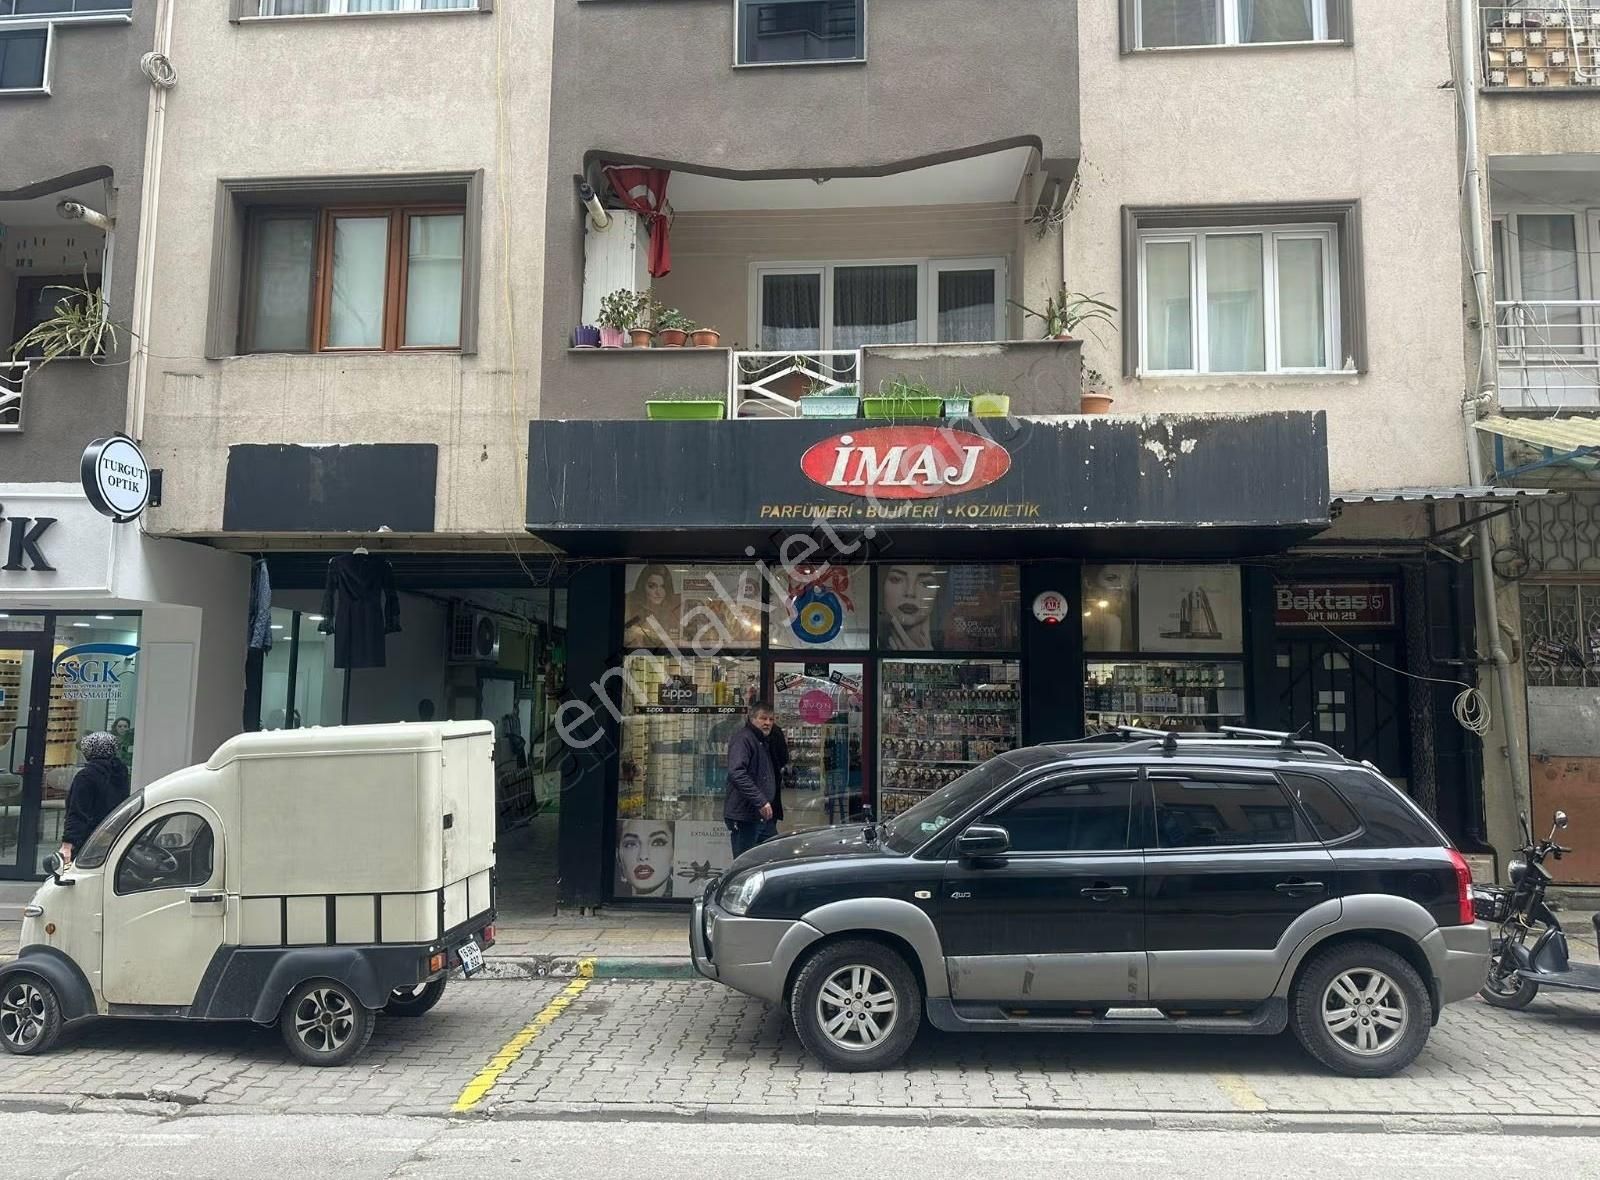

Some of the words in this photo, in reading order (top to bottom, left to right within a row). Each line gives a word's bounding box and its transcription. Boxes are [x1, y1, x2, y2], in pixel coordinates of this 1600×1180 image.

[103, 457, 145, 479] TURGUT
[825, 435, 985, 487] İMAJ
[107, 474, 139, 493] OPTİK
[759, 502, 852, 519] PARFÜMERİ
[954, 502, 1040, 518] KOZMETİK
[63, 660, 121, 683] SGK
